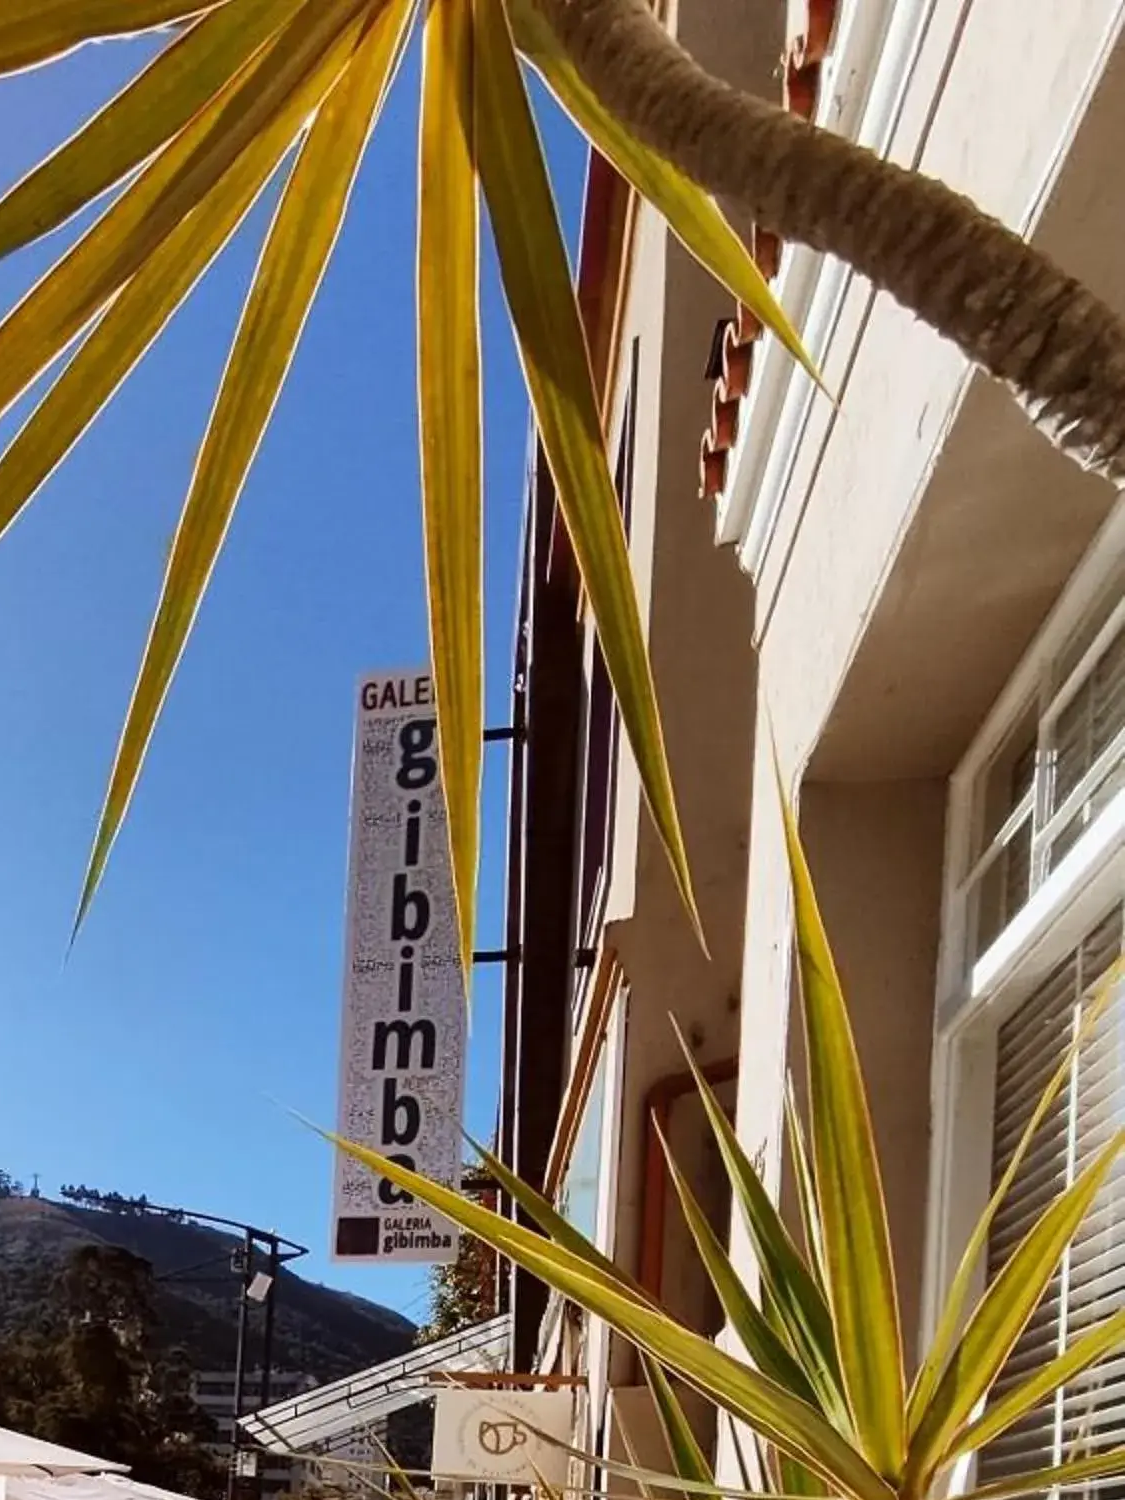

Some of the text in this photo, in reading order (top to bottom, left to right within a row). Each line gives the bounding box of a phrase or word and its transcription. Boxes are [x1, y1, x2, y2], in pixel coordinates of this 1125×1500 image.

[361, 676, 436, 711] GALE
[384, 1217, 432, 1231] GALERIA
[383, 1231, 452, 1254] gibimba
